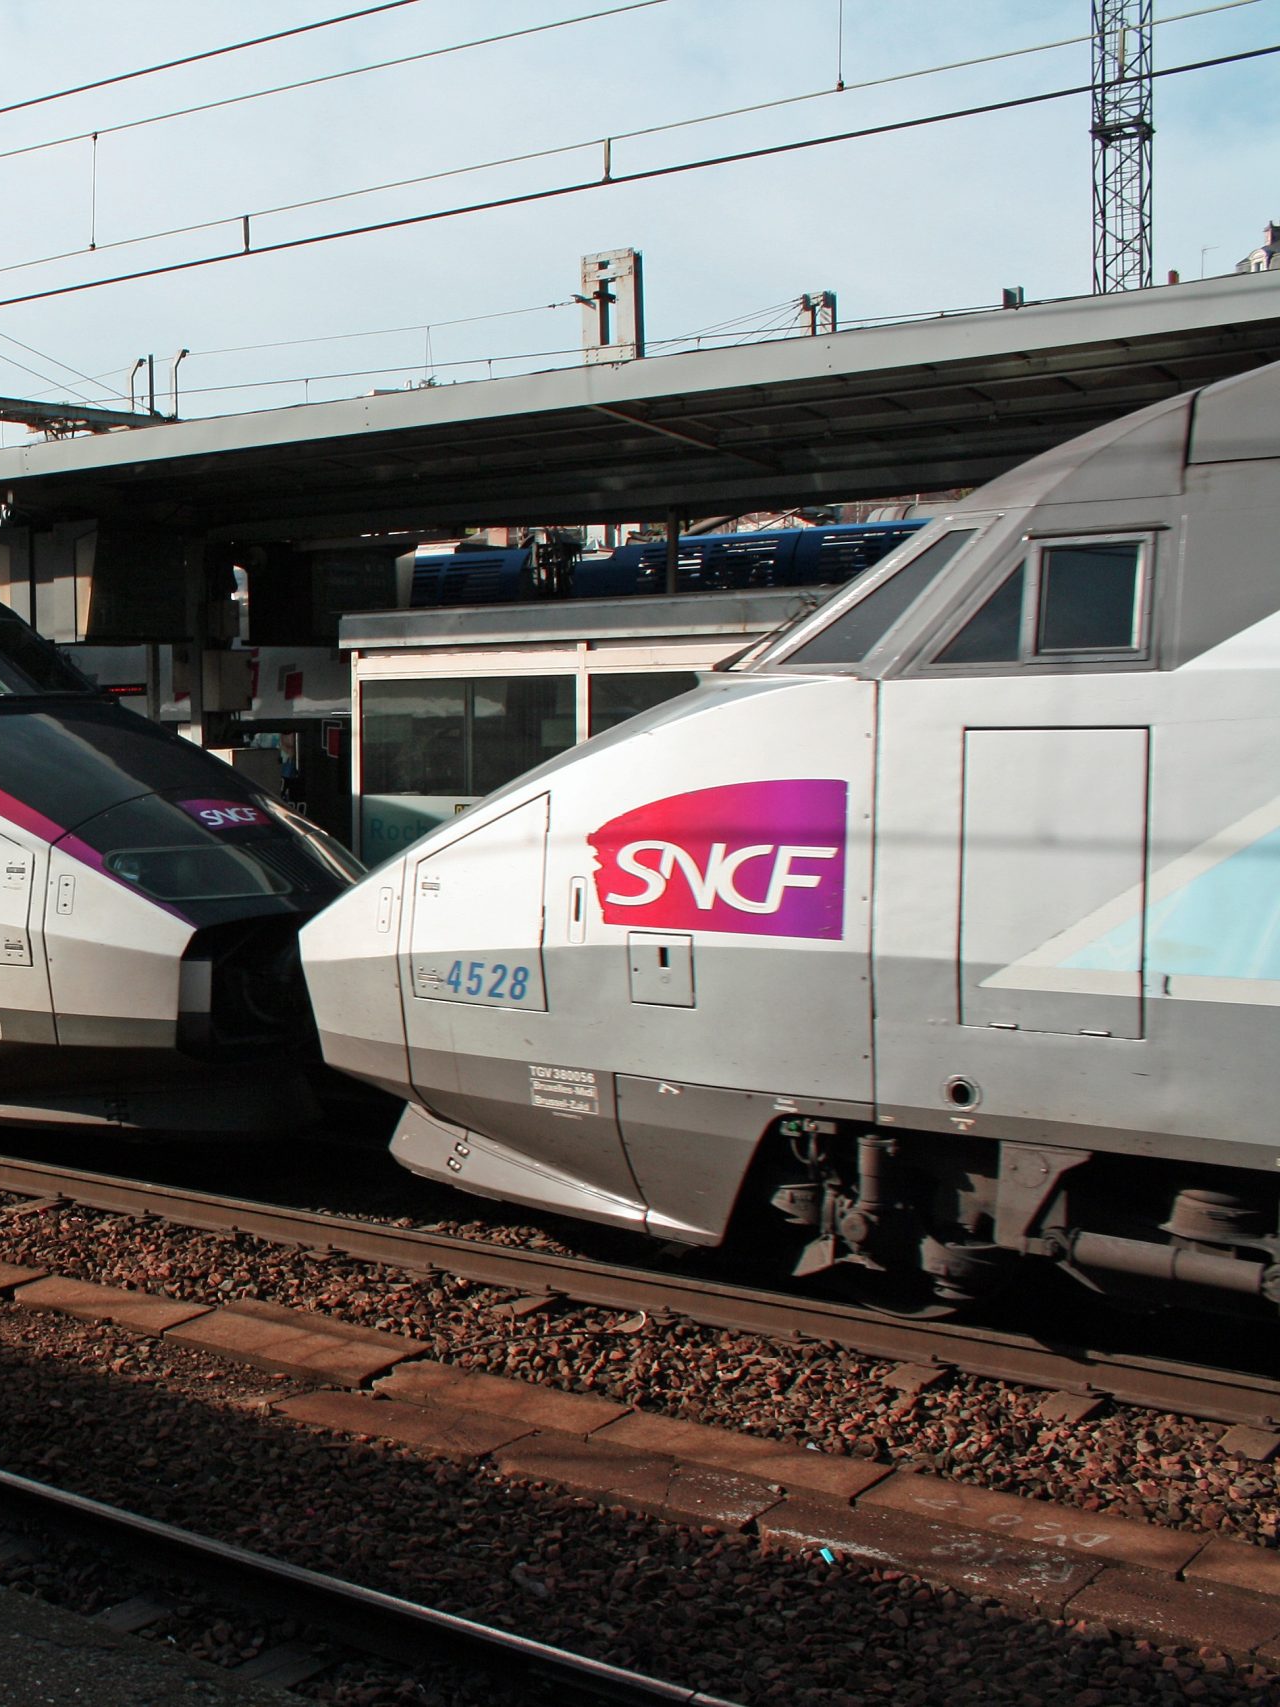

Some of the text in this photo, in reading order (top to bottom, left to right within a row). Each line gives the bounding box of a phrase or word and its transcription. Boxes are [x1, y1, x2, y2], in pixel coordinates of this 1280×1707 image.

[200, 807, 257, 826] SNCF
[605, 839, 839, 914] SNCF
[446, 959, 530, 1001] 4528
[528, 1065, 553, 1078] TGV
